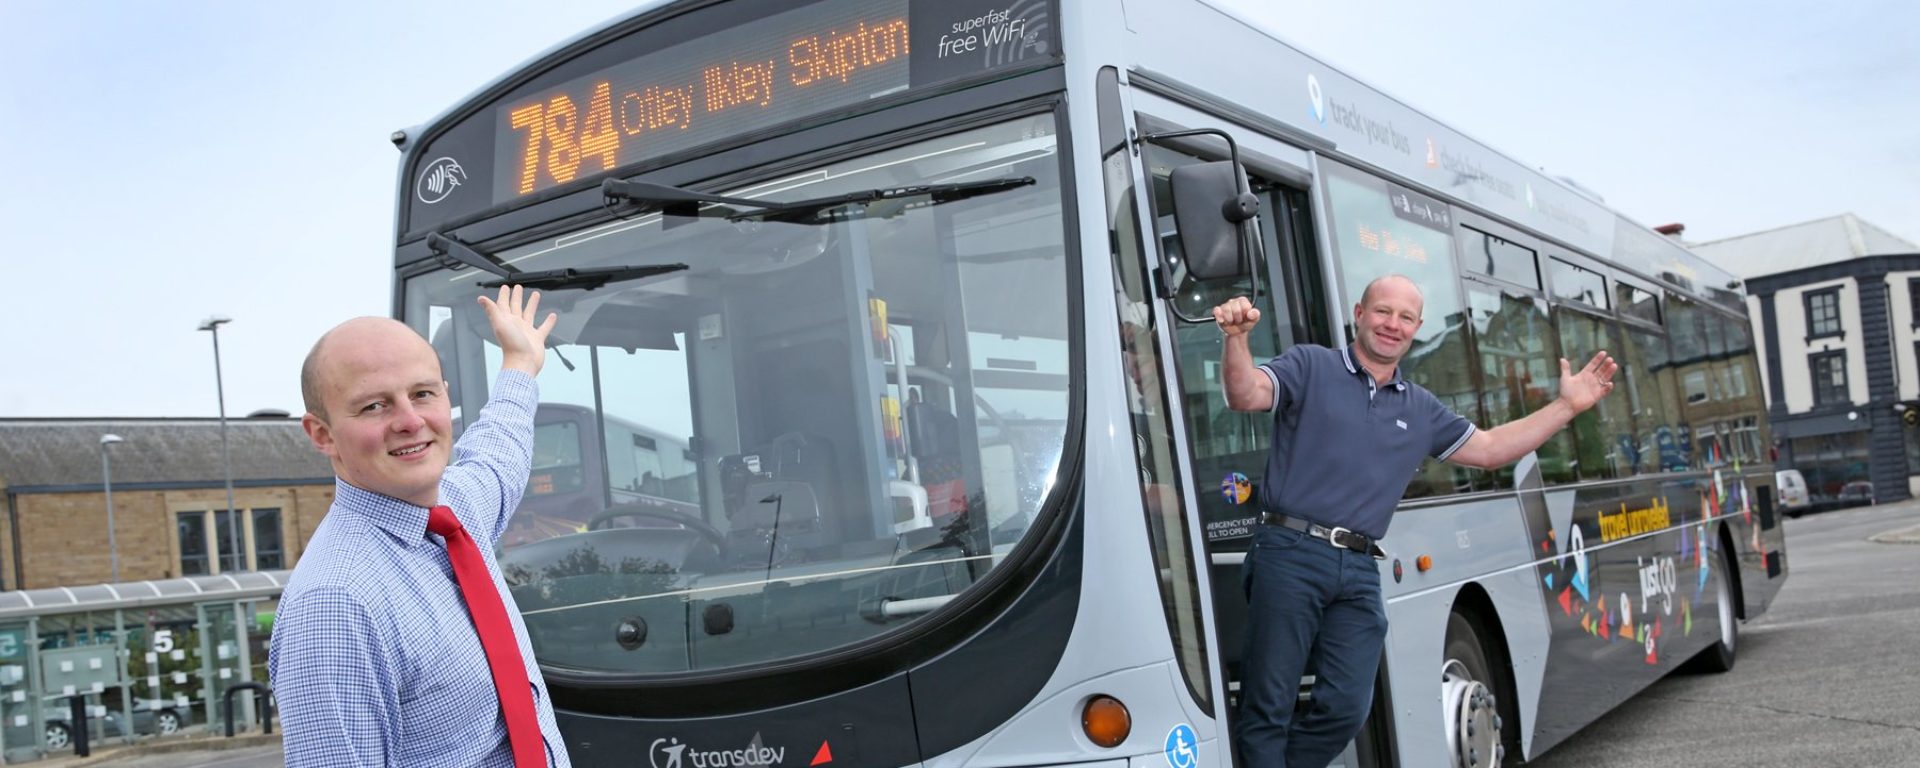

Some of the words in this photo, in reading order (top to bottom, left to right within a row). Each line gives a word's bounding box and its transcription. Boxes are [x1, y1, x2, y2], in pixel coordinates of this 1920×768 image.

[938, 34, 977, 58] free
[982, 19, 1025, 47] WiFi
[952, 9, 1010, 33] superfast
[511, 81, 620, 194] 784
[621, 84, 693, 135] Otley
[704, 59, 774, 112] Ilkley
[789, 20, 909, 86] Skipton
[1329, 96, 1364, 136] track
[1362, 115, 1390, 146] your
[1388, 119, 1410, 154] bus
[1219, 529, 1228, 537] TO
[1229, 527, 1248, 536] OPEN
[1598, 502, 1630, 543] travel
[1638, 556, 1662, 614] just
[1660, 556, 1676, 616] go
[153, 630, 174, 653] 5
[688, 743, 785, 768] transdev
